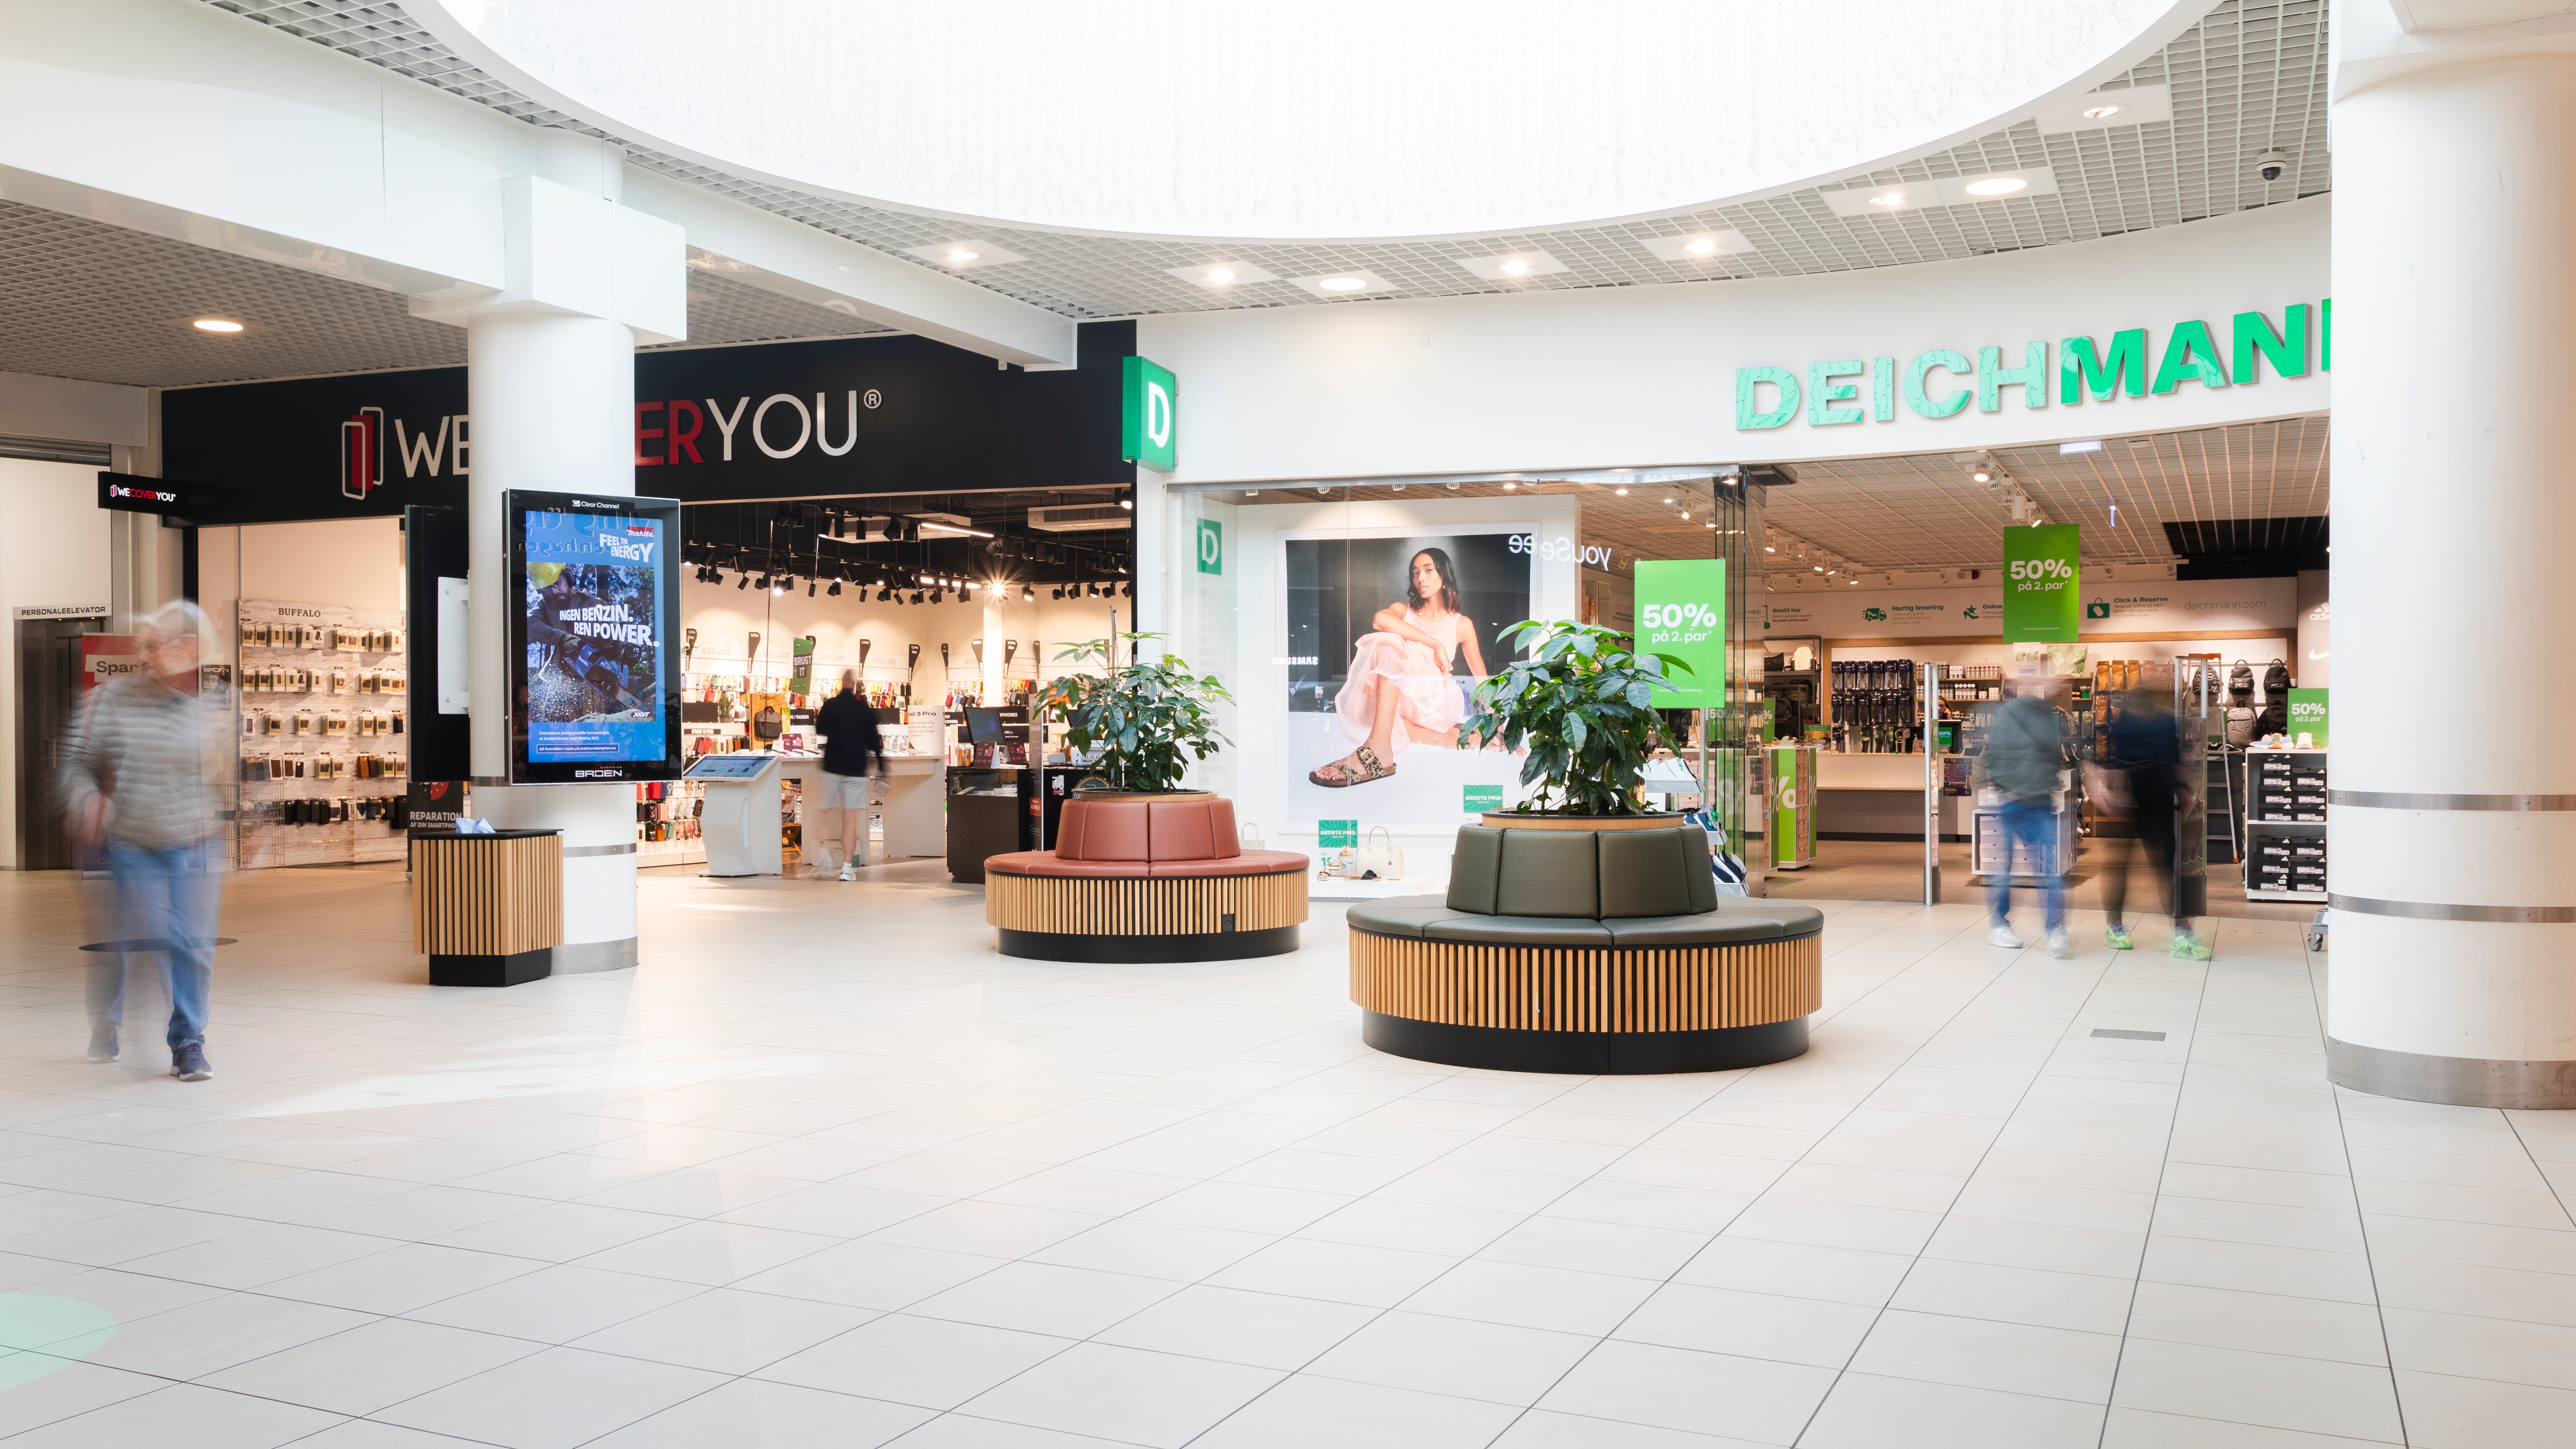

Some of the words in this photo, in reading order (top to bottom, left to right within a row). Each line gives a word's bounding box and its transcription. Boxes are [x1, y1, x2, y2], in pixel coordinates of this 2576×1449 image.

[1736, 298, 2331, 431] DEICHMAN
[1149, 381, 1170, 448] D
[600, 533, 620, 547] FEEL
[1202, 528, 1219, 565] D
[611, 542, 654, 563] ENERGY
[2010, 559, 2072, 580] 50%
[2018, 581, 2032, 592] på
[2034, 582, 2044, 590] 2.
[2184, 600, 2266, 610] deichmann.com
[21, 606, 106, 616] PERSONALEELEVATOR
[278, 608, 321, 617] BUFFALO
[560, 608, 581, 621] INGEN
[582, 604, 634, 623] BENZIN.
[1642, 603, 1717, 629] 50%
[1197, 623, 1216, 633] LONDON
[574, 621, 591, 637] REN
[594, 621, 660, 647] POWER.
[1197, 635, 1210, 643] ROMA
[1652, 630, 1669, 644] på
[1671, 631, 1682, 642] 2.
[1197, 647, 1215, 656] ZAGREB
[794, 656, 812, 666] BRUGT
[1197, 659, 1214, 667] VILNIUS
[799, 667, 805, 677] IT
[2291, 703, 2326, 715] 50%
[1198, 765, 1225, 774] STOCKHOLM
[410, 811, 462, 821] REPARATION
